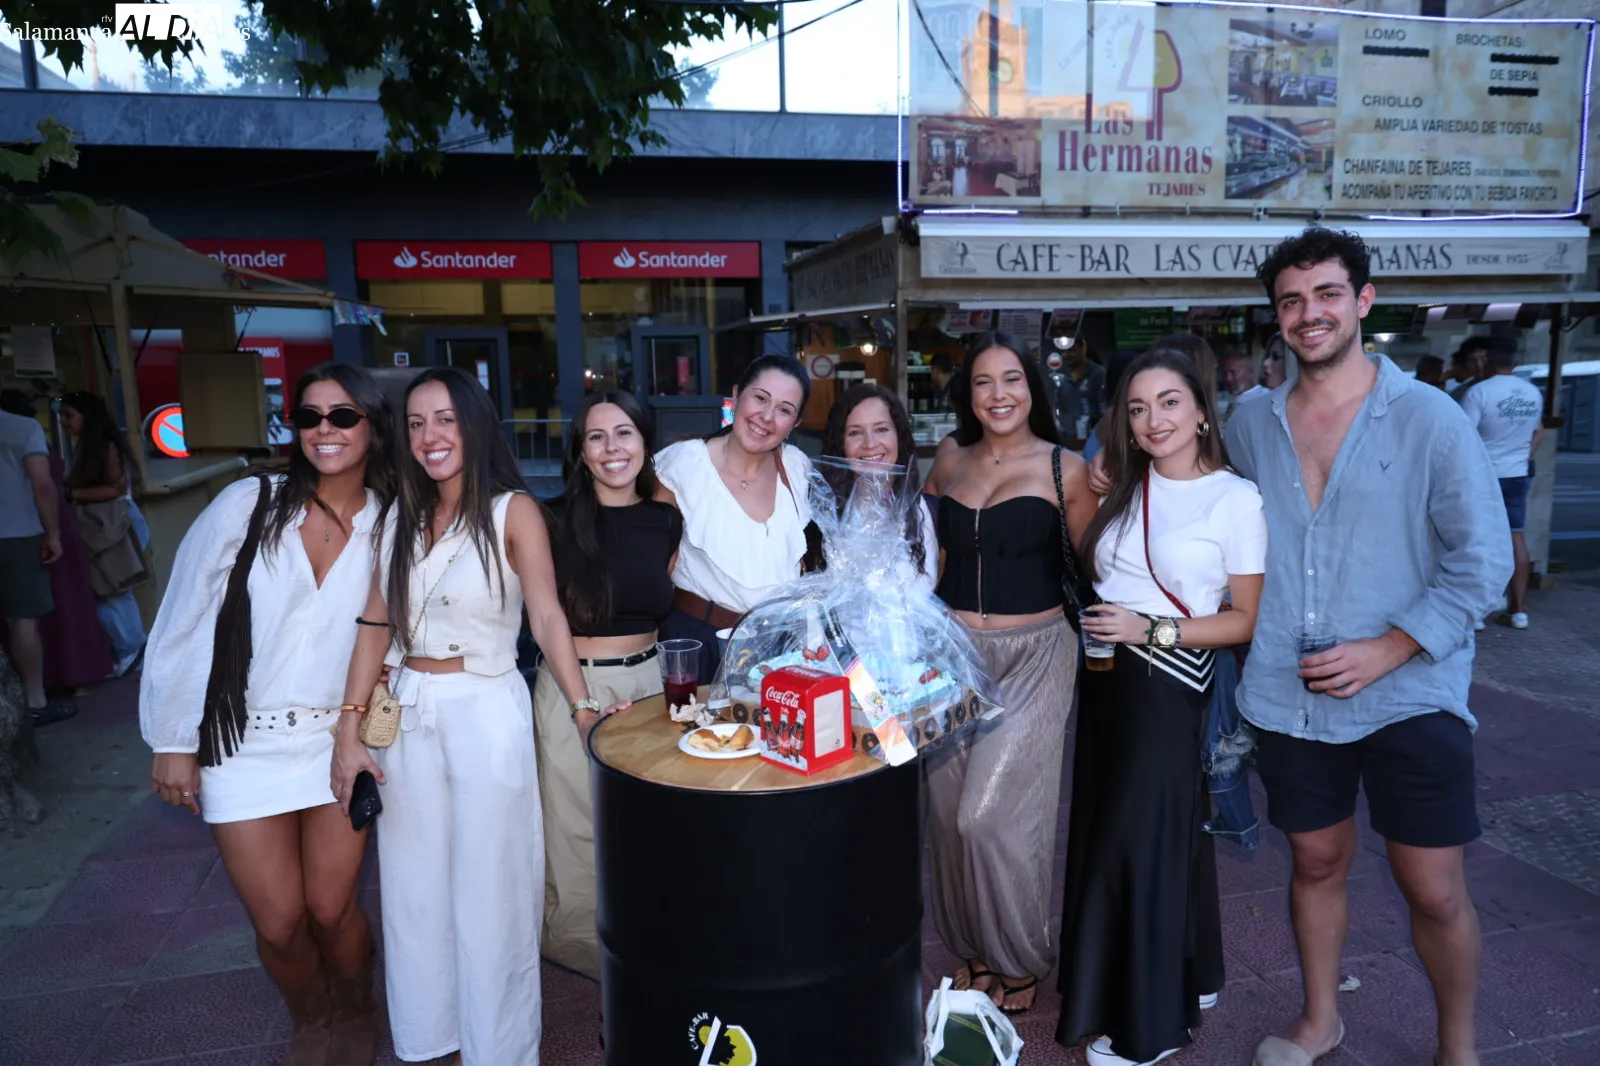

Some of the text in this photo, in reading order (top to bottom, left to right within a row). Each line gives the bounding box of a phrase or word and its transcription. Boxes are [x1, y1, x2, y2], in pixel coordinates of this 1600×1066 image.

[1364, 28, 1406, 41] LOMO
[1490, 69, 1538, 82] DE SEPIA
[1362, 95, 1423, 108] CRIOLLO
[1085, 93, 1133, 136] Las
[1374, 118, 1543, 135] AMPLIA VARIEDAD DE TOSTAS
[1056, 130, 1214, 174] Hermanas
[1343, 158, 1405, 175] CHANFAINA
[1408, 160, 1423, 175] DE
[1426, 160, 1472, 176] TEJARES
[1147, 182, 1206, 196] TEJARES
[1341, 180, 1392, 200] ACOMPAÑA
[1454, 185, 1473, 200] CON
[420, 251, 517, 268] Santander
[638, 251, 728, 268] Santander
[1154, 243, 1202, 272] LAS
[1369, 242, 1452, 271] MANAS
